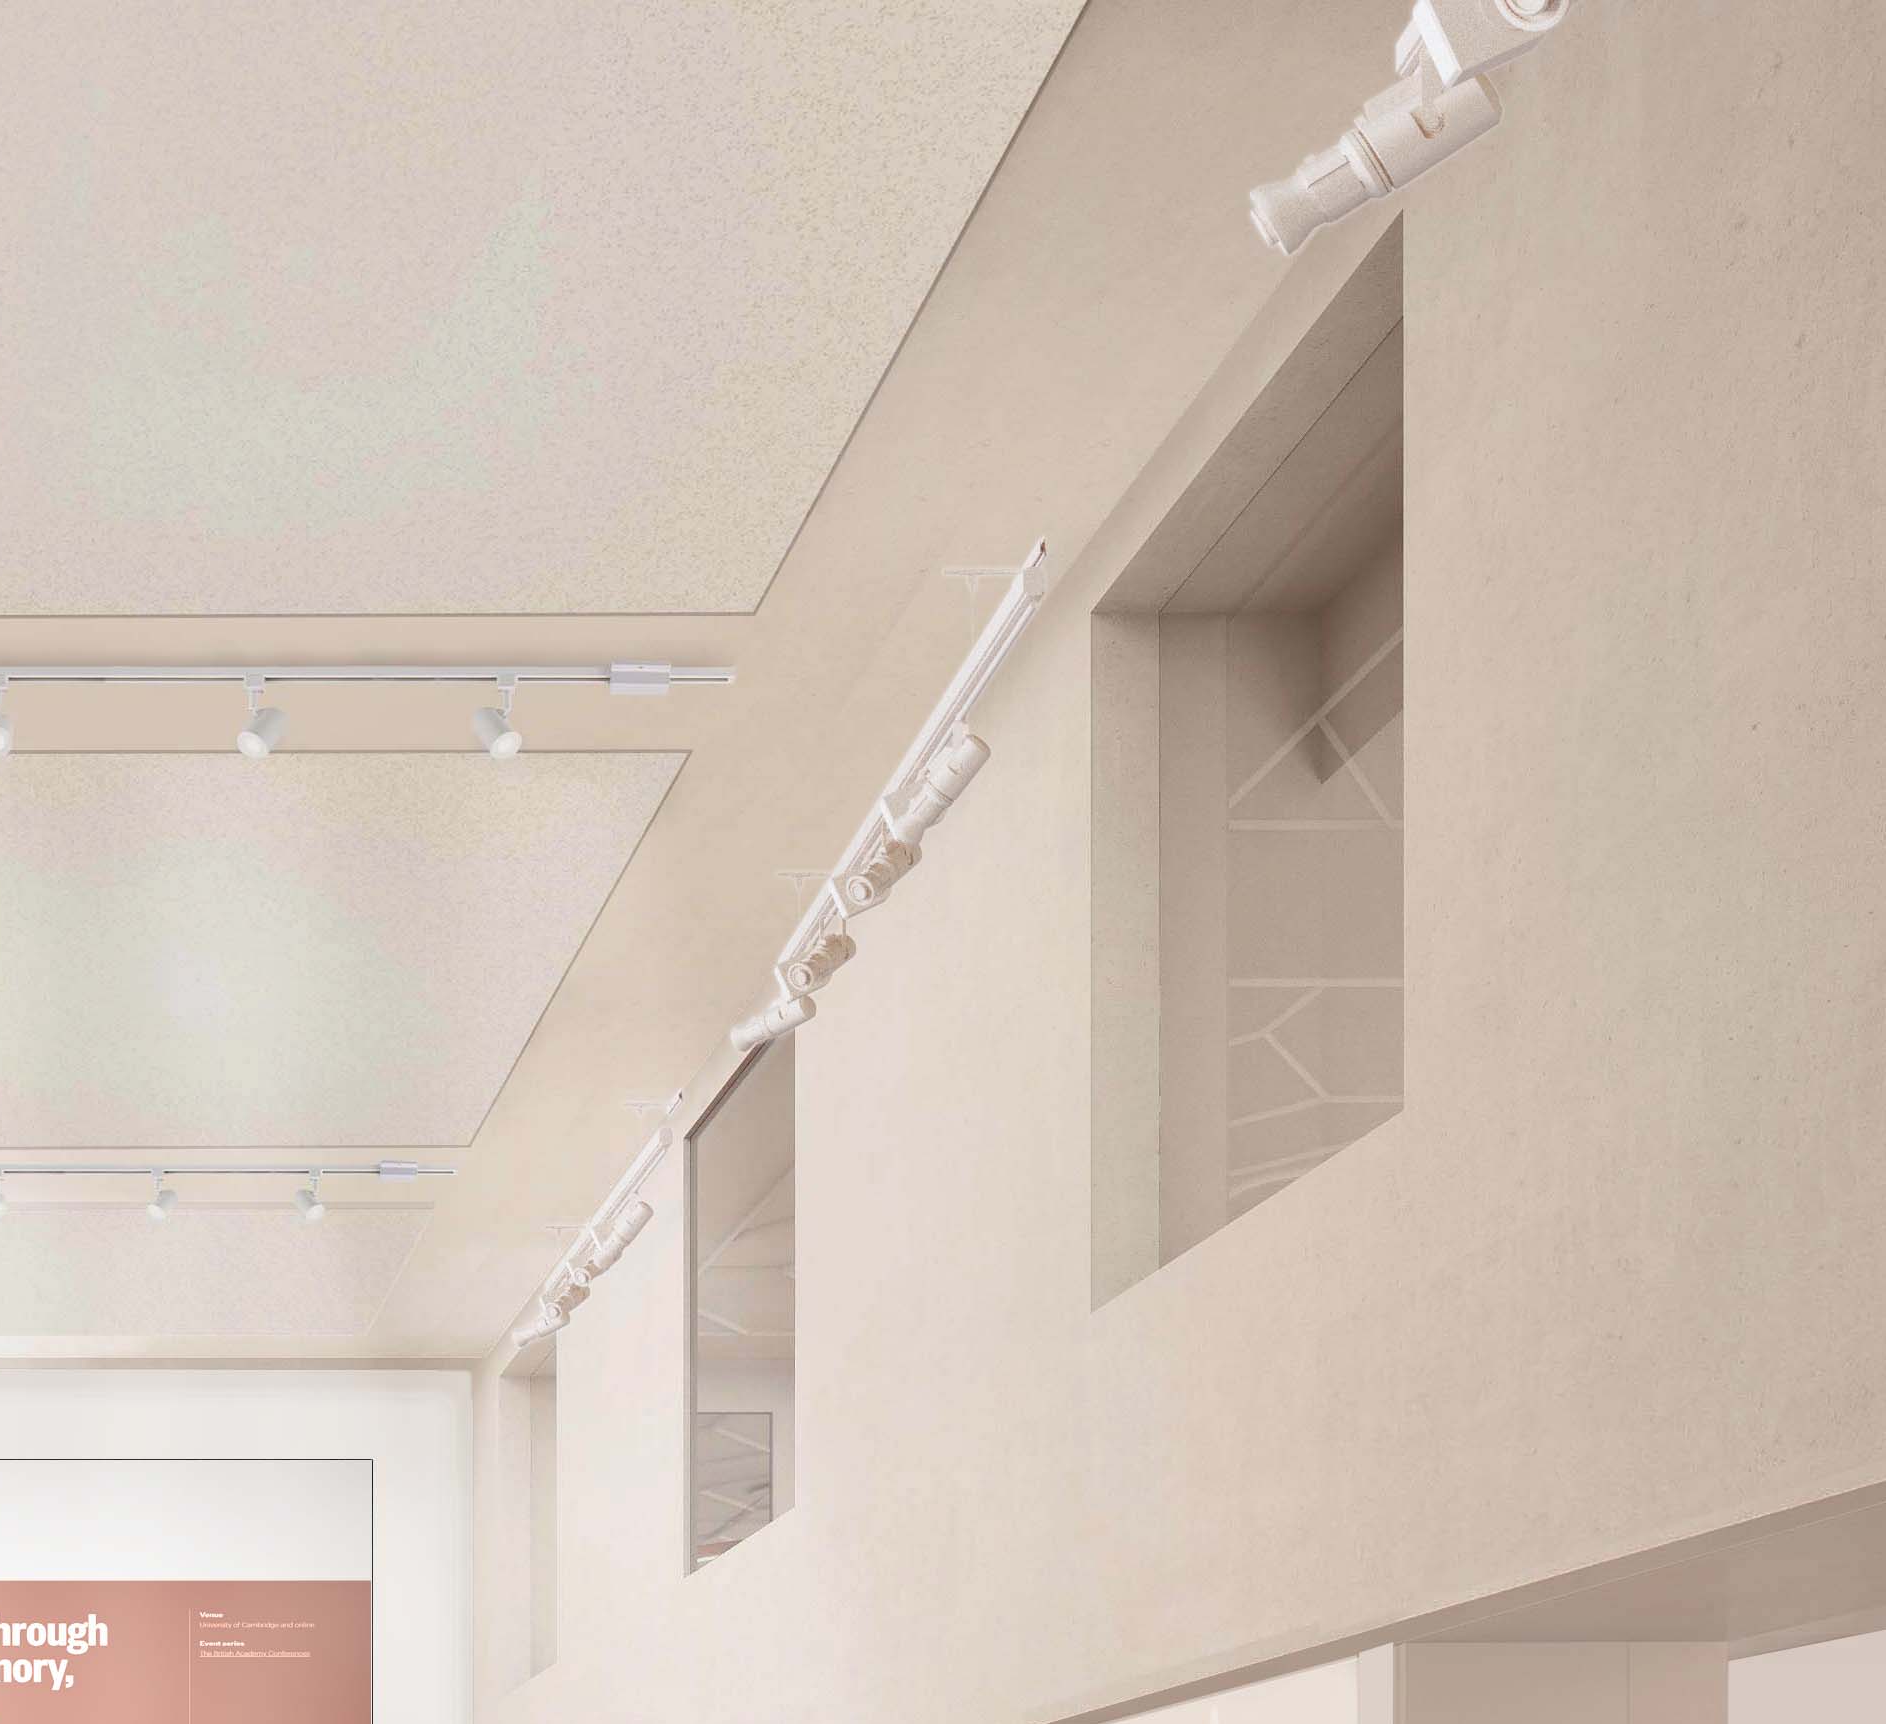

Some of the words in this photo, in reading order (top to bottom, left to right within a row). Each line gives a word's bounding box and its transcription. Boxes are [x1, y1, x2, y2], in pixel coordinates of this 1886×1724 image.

[199, 1621, 232, 1629] University
[233, 1621, 240, 1629] of
[241, 1621, 280, 1630] Cambridge
[280, 1621, 293, 1629] and
